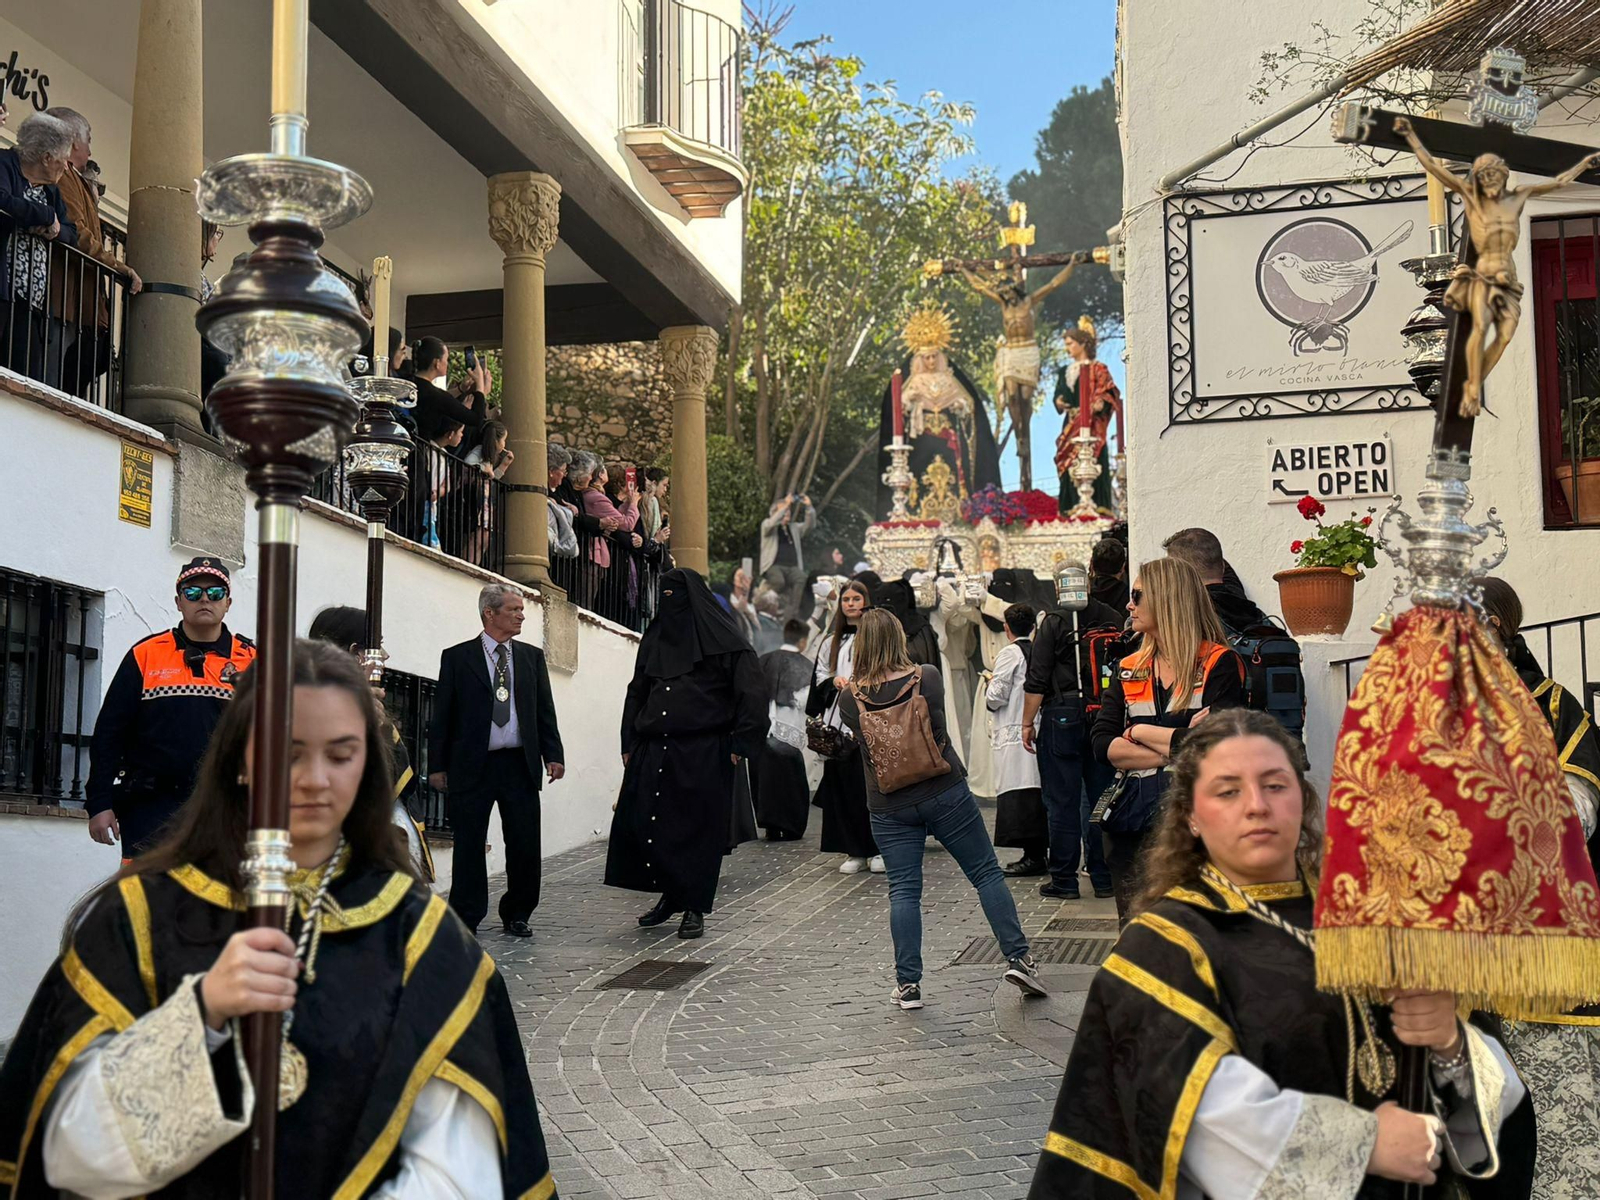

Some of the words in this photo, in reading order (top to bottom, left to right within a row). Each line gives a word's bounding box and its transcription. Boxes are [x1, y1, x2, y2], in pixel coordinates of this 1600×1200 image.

[1279, 376, 1321, 385] COCINA
[1326, 373, 1364, 382] VASCA
[1271, 442, 1386, 472] ABIERTO
[1318, 469, 1388, 495] OPEN
